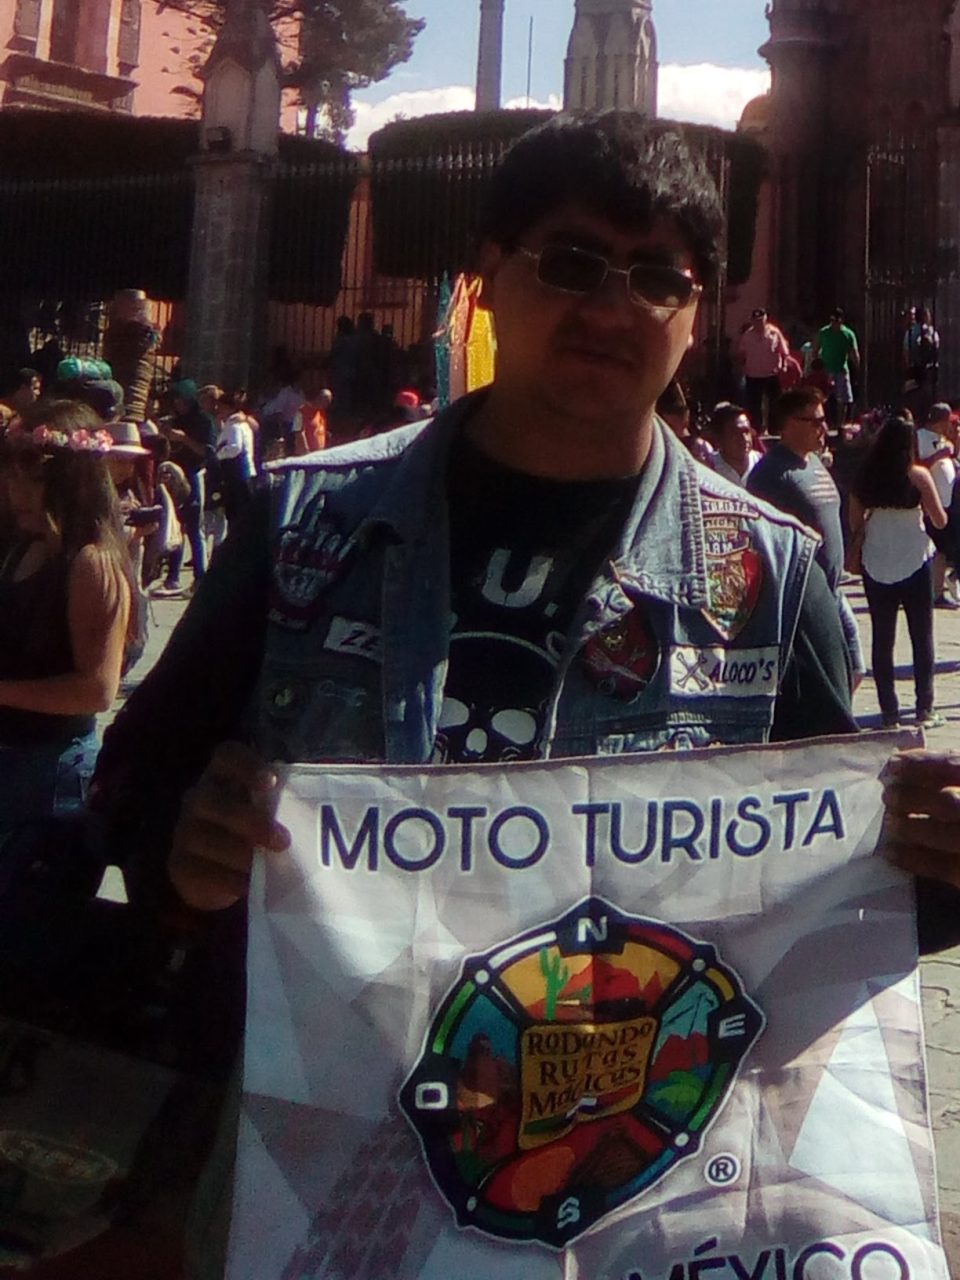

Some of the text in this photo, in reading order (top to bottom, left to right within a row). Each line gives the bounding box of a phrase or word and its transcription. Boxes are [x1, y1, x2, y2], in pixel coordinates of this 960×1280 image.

[321, 789, 845, 872] MOTO TURISTA
[578, 916, 608, 942] N
[718, 1013, 746, 1039] E
[415, 1081, 449, 1110] O
[557, 1196, 580, 1229] S
[626, 1237, 912, 1280] ÉXICO
